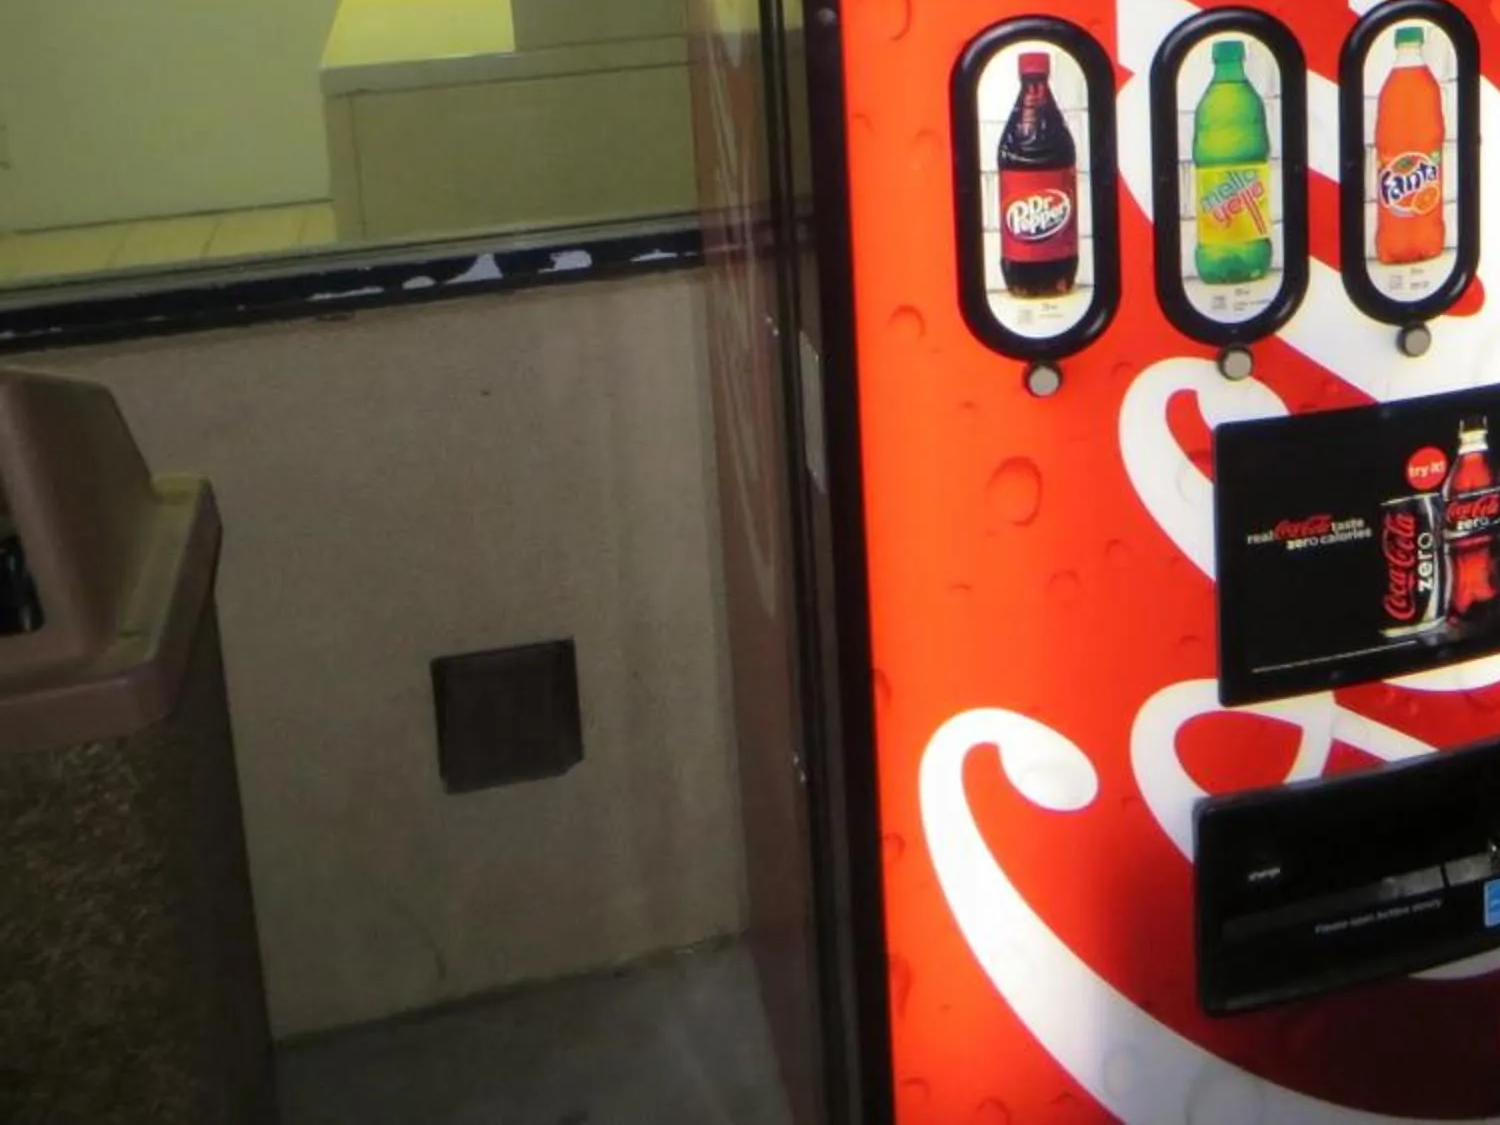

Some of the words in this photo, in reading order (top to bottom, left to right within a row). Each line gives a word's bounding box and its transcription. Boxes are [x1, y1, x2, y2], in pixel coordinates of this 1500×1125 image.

[1408, 463, 1430, 478] try
[1247, 531, 1275, 545] real
[1331, 517, 1365, 532] taste
[1286, 535, 1319, 551] zero
[1319, 527, 1373, 545] calories
[1417, 531, 1435, 593] zero
